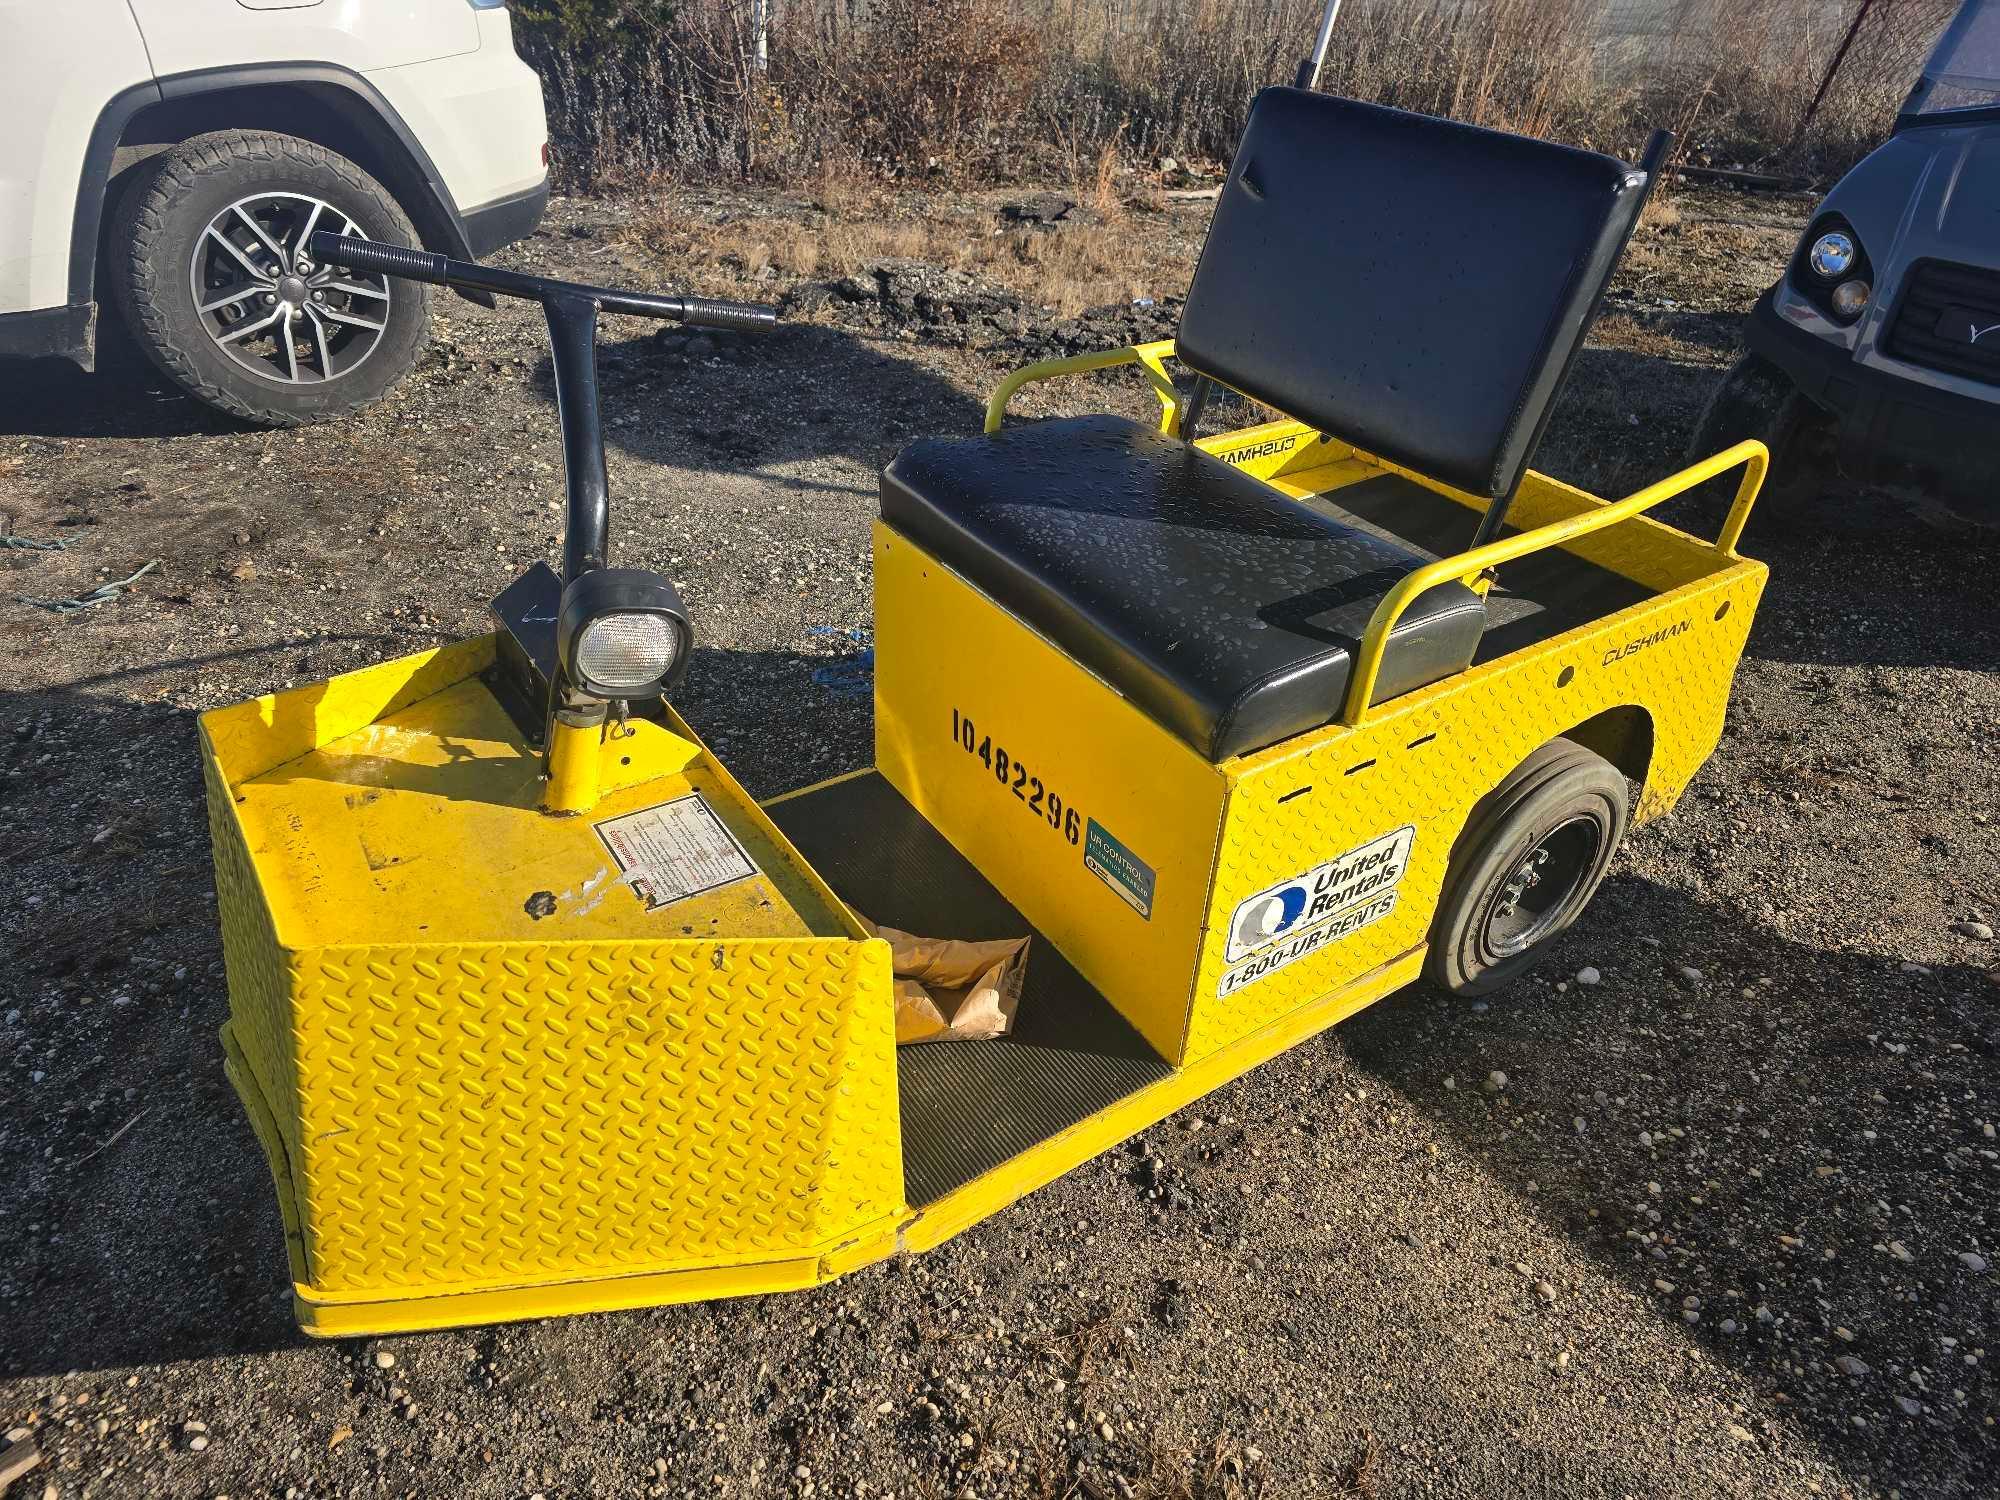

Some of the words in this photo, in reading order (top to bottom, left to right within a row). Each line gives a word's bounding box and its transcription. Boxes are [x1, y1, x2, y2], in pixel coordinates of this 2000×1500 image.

[1602, 618, 1693, 666] CUSHMAN
[953, 708, 1081, 845] 10482296
[1103, 844, 1143, 882] CONTROL
[1308, 863, 1399, 920] Rentals
[1314, 838, 1399, 895] United
[1226, 894, 1394, 991] 1-800-UR-RENTS
